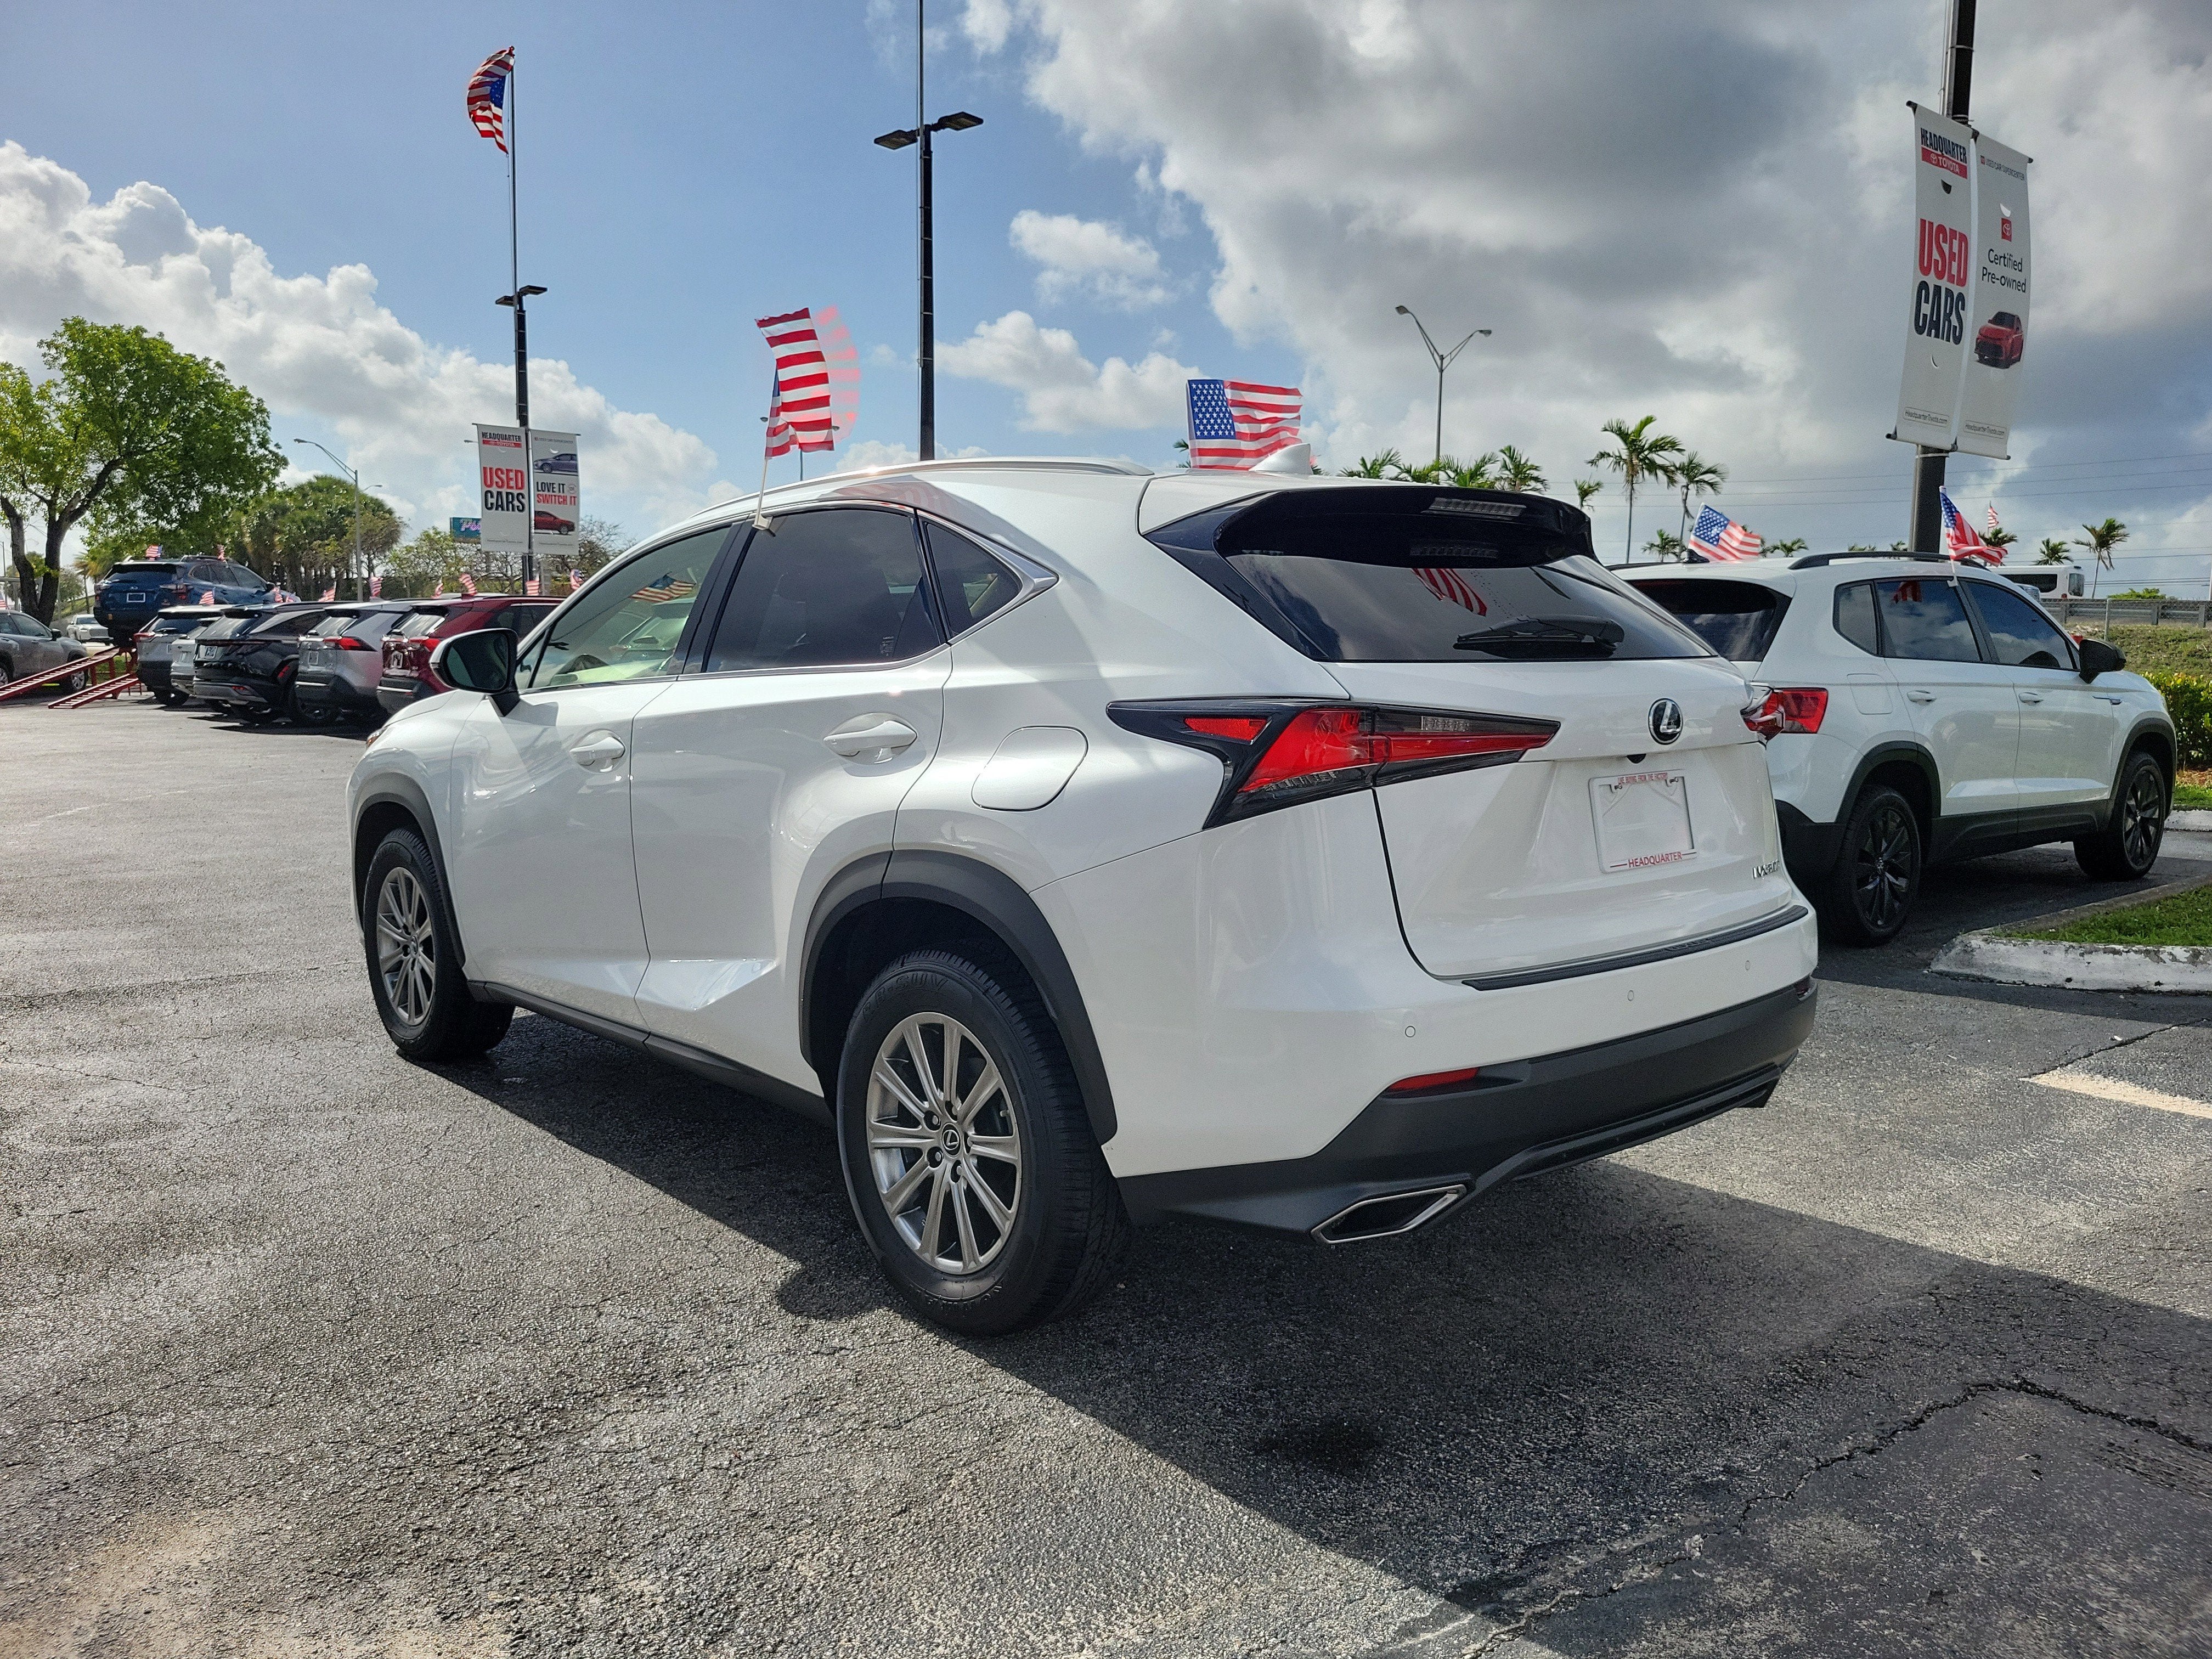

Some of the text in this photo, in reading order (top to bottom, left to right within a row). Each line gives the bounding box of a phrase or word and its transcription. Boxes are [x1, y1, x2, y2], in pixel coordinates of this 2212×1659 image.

[1921, 128, 1967, 165] HEADQUARTER
[1919, 218, 1968, 287] USED
[1988, 249, 2023, 273] Certified
[1982, 267, 2027, 293] Pre-owned
[1914, 280, 1965, 345] CARS
[482, 432, 522, 442] HEADQUARTER
[483, 466, 525, 490] USED
[537, 481, 566, 493] LOVE IT
[484, 490, 526, 513] CARS
[537, 493, 578, 506] SWITCH IT
[1628, 851, 1683, 868] HEADQUARTER
